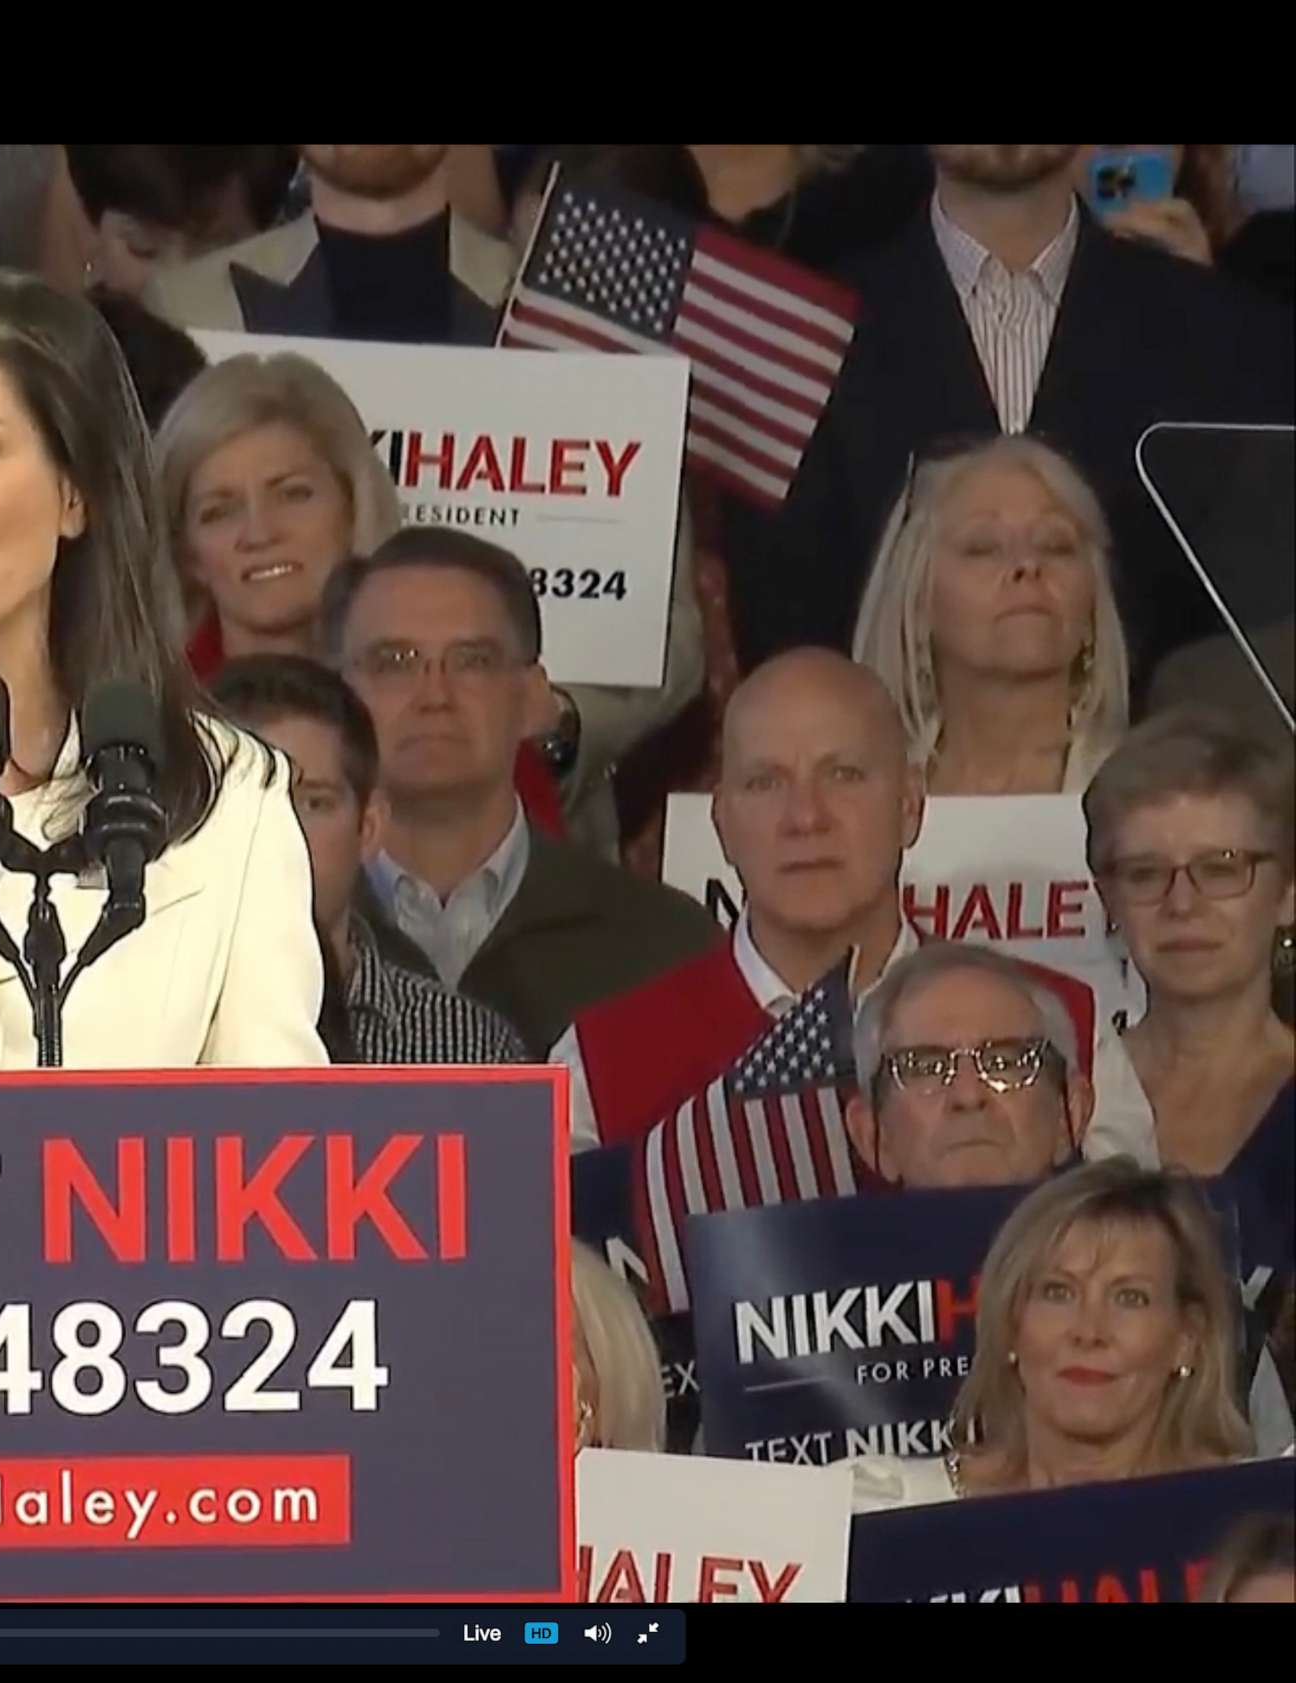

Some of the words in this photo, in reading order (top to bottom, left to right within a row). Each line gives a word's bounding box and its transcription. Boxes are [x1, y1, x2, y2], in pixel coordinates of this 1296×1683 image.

[371, 429, 641, 497] IHALEY
[404, 503, 520, 526] ESIDENT
[41, 1132, 468, 1265] NIKKI
[856, 1359, 910, 1386] FOR
